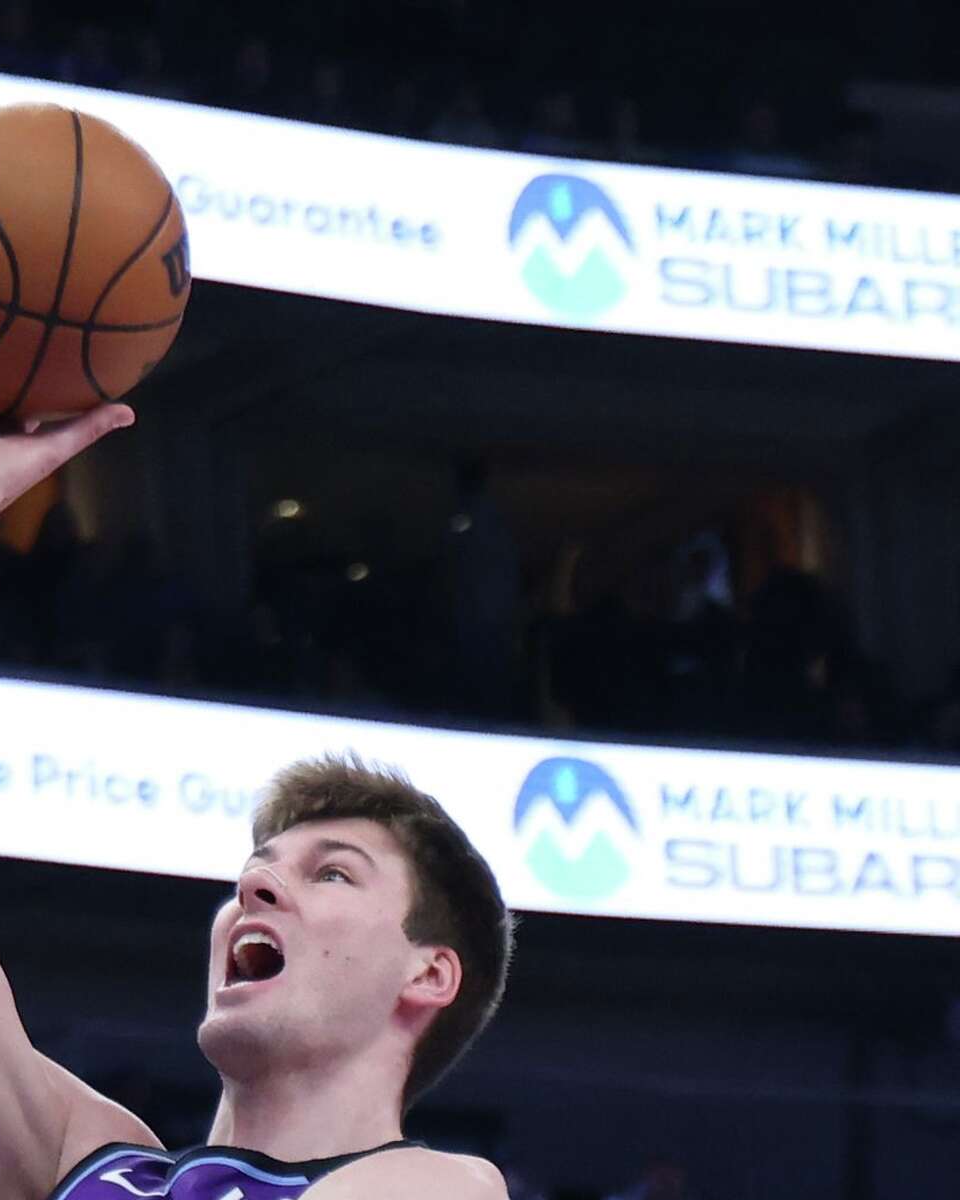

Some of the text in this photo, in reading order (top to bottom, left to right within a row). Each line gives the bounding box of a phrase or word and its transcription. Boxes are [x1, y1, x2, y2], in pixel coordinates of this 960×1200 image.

[176, 174, 444, 255] Guarantee
[653, 202, 960, 270] MARK MILL
[29, 751, 162, 808] Price
[657, 783, 960, 840] MARK MILL
